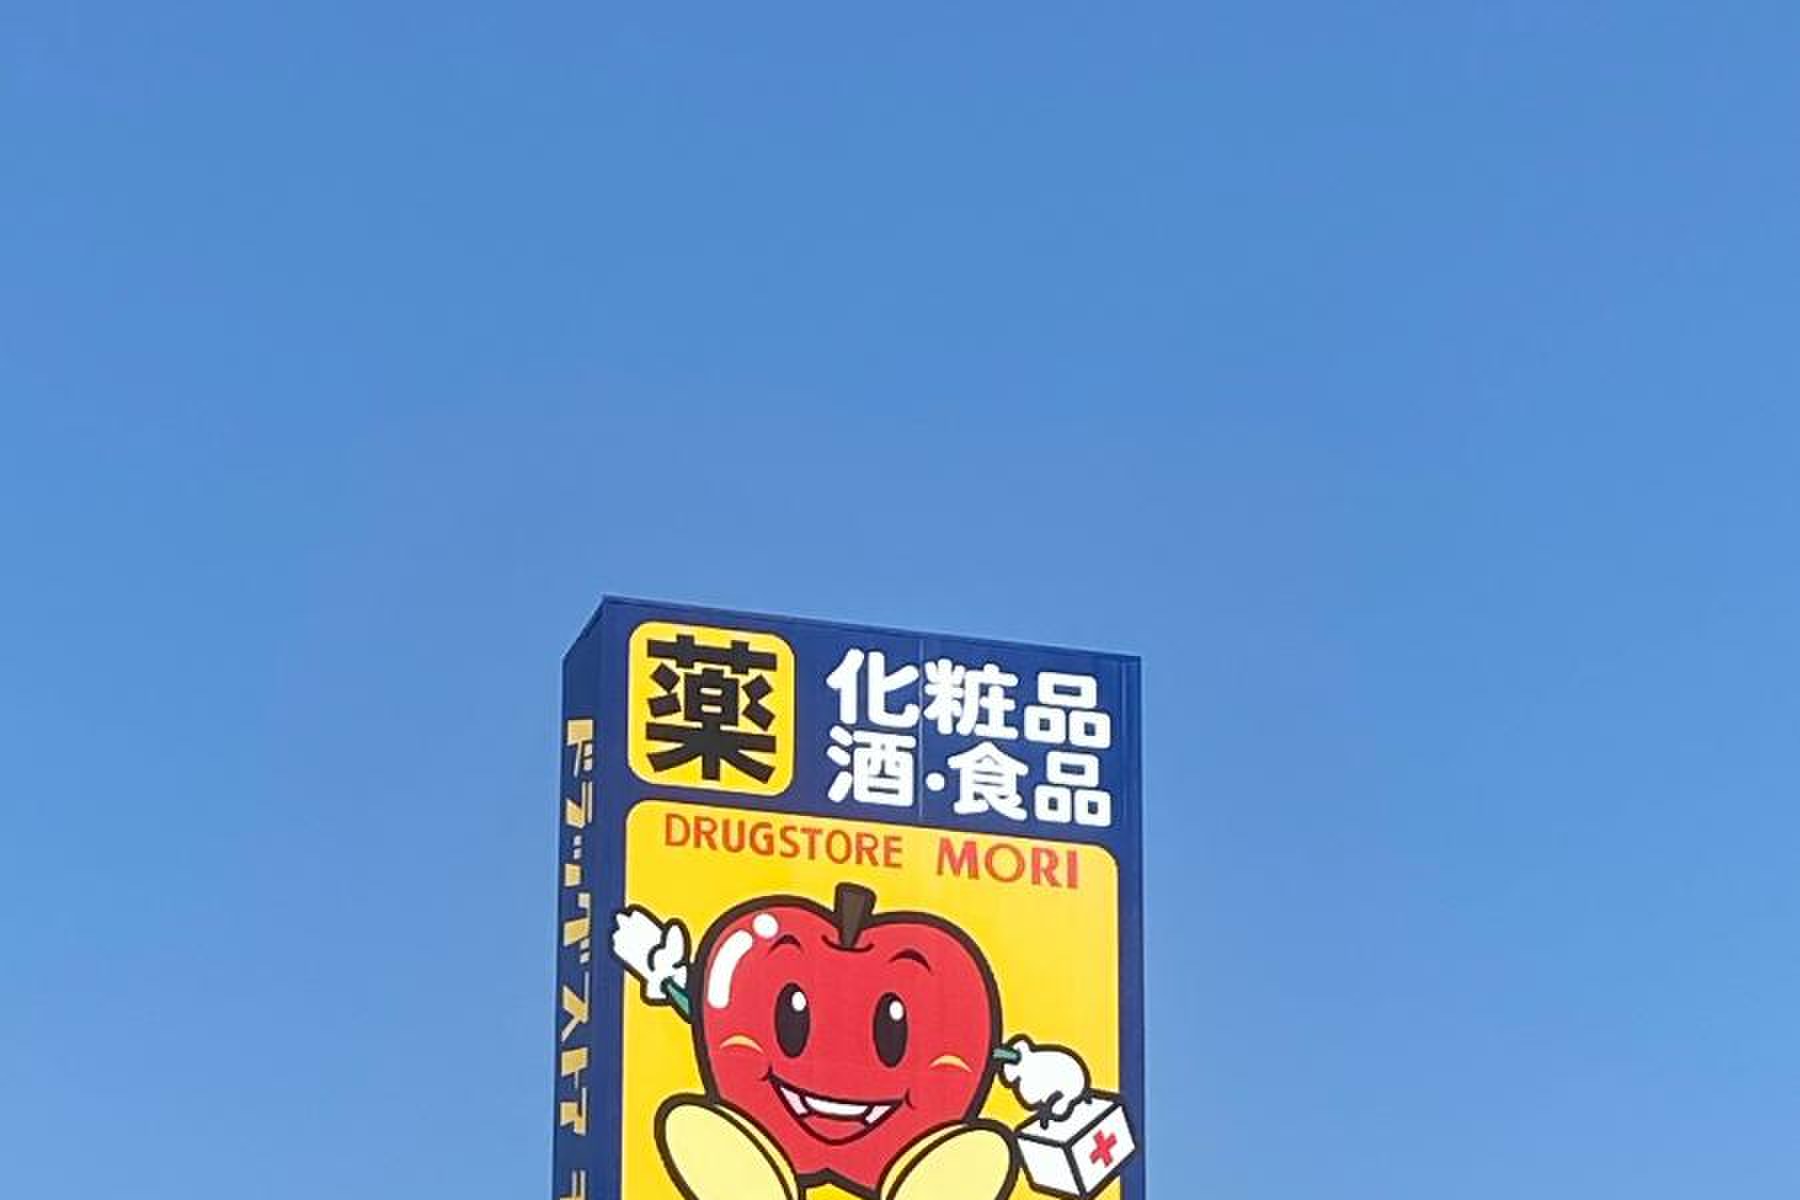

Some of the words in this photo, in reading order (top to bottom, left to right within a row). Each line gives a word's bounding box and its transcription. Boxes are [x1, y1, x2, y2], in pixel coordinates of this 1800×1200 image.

[645, 634, 778, 782] 薬
[825, 647, 1112, 750] 化粧品
[664, 812, 903, 870] DRUGSTORE
[936, 837, 1080, 890] MORI
